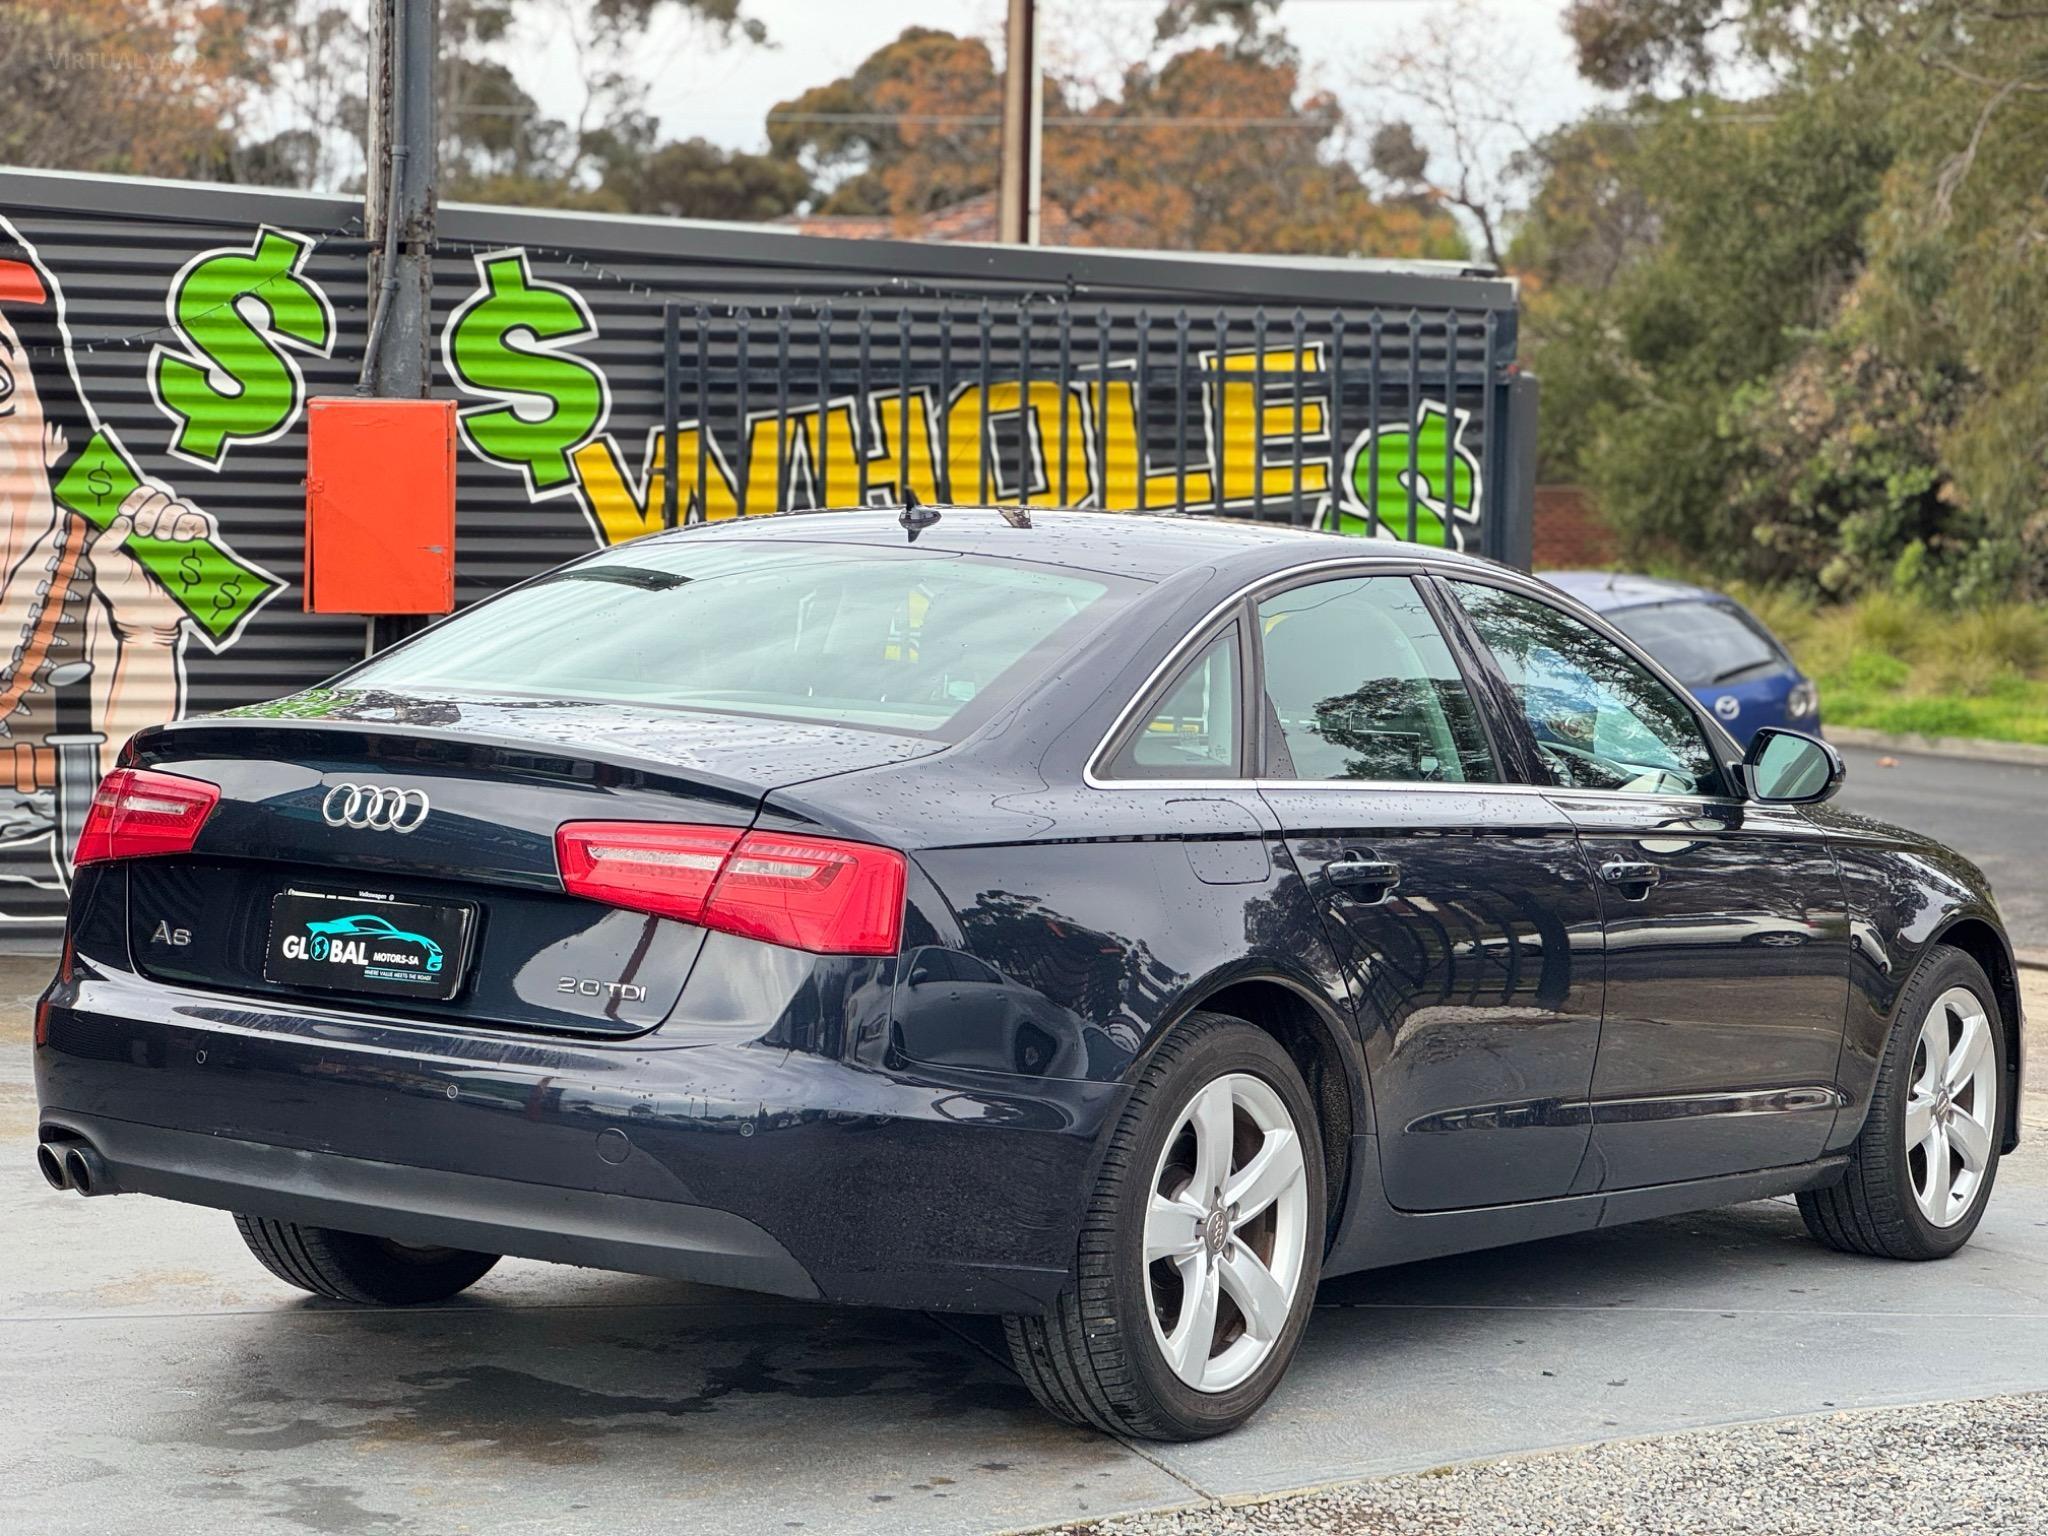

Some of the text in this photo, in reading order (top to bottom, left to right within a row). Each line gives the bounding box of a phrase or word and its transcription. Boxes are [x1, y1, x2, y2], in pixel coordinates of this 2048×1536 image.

[150, 919, 193, 947] A6
[282, 934, 420, 967] GLOBAL MOTORS-SA
